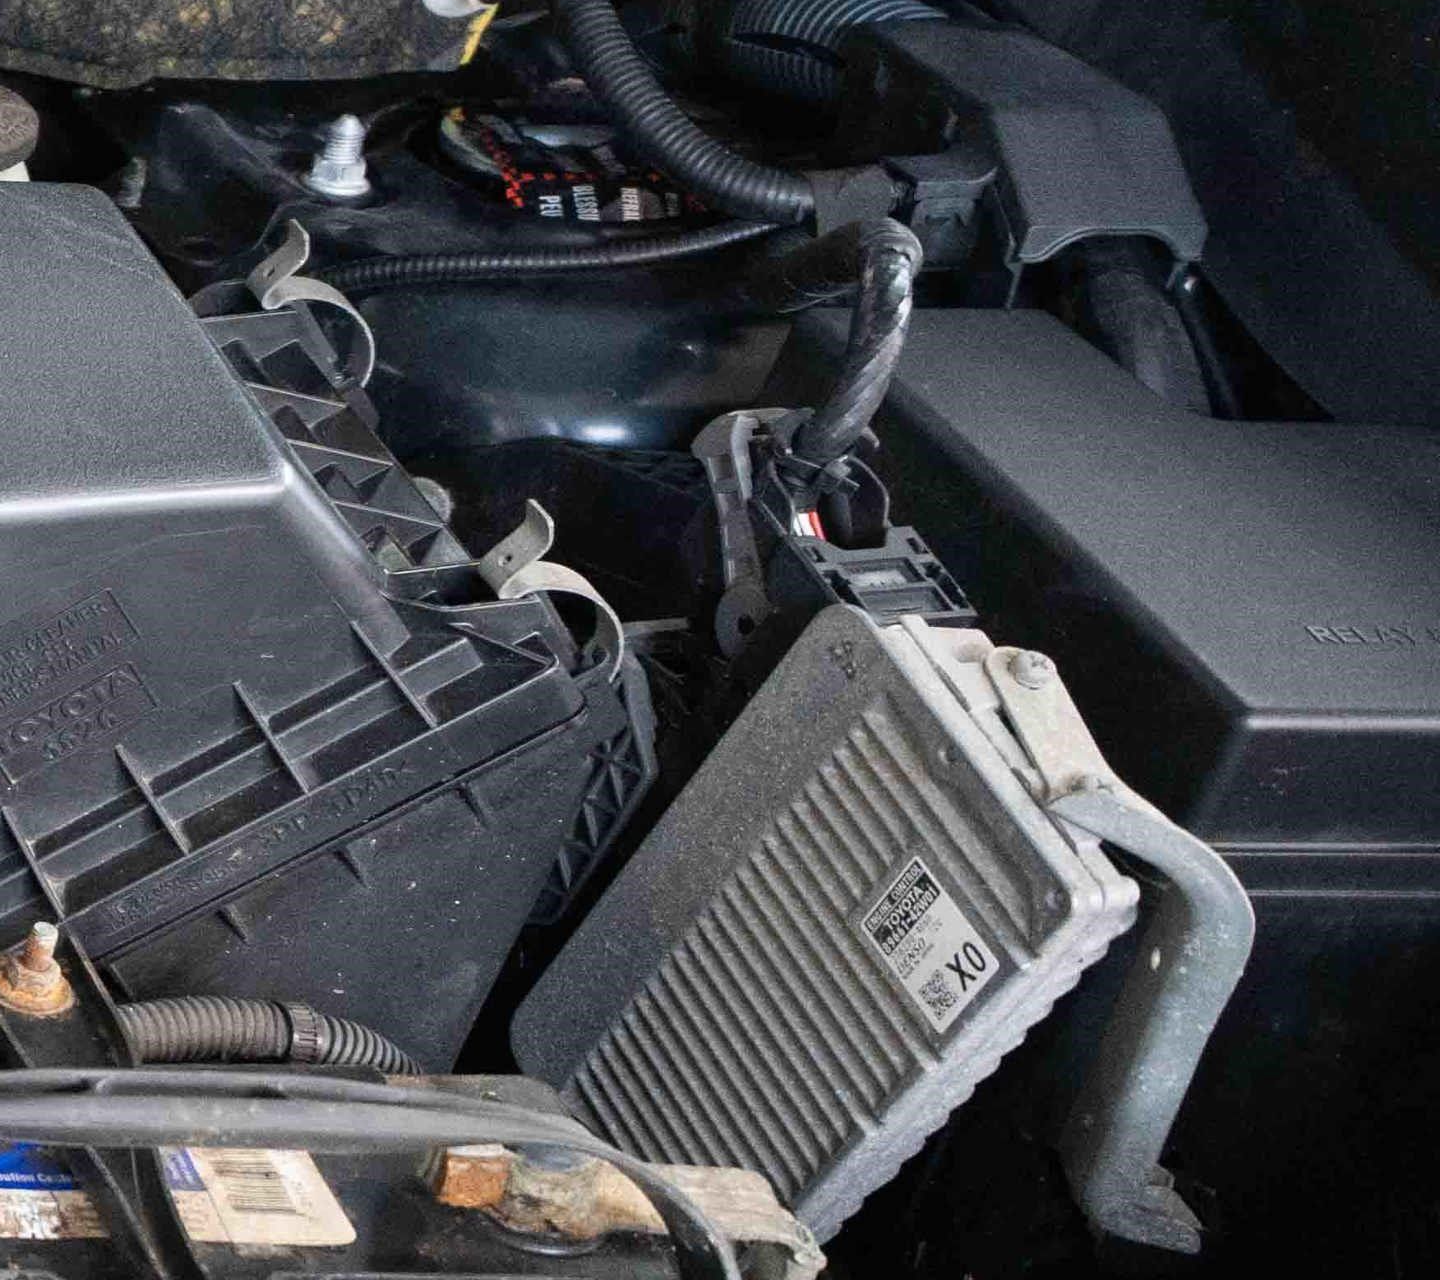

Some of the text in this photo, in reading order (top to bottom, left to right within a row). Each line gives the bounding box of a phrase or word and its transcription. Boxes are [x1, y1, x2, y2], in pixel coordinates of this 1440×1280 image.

[1304, 624, 1416, 646] RELAY
[890, 863, 922, 901] CONTROL
[883, 886, 926, 931] TOYOTA
